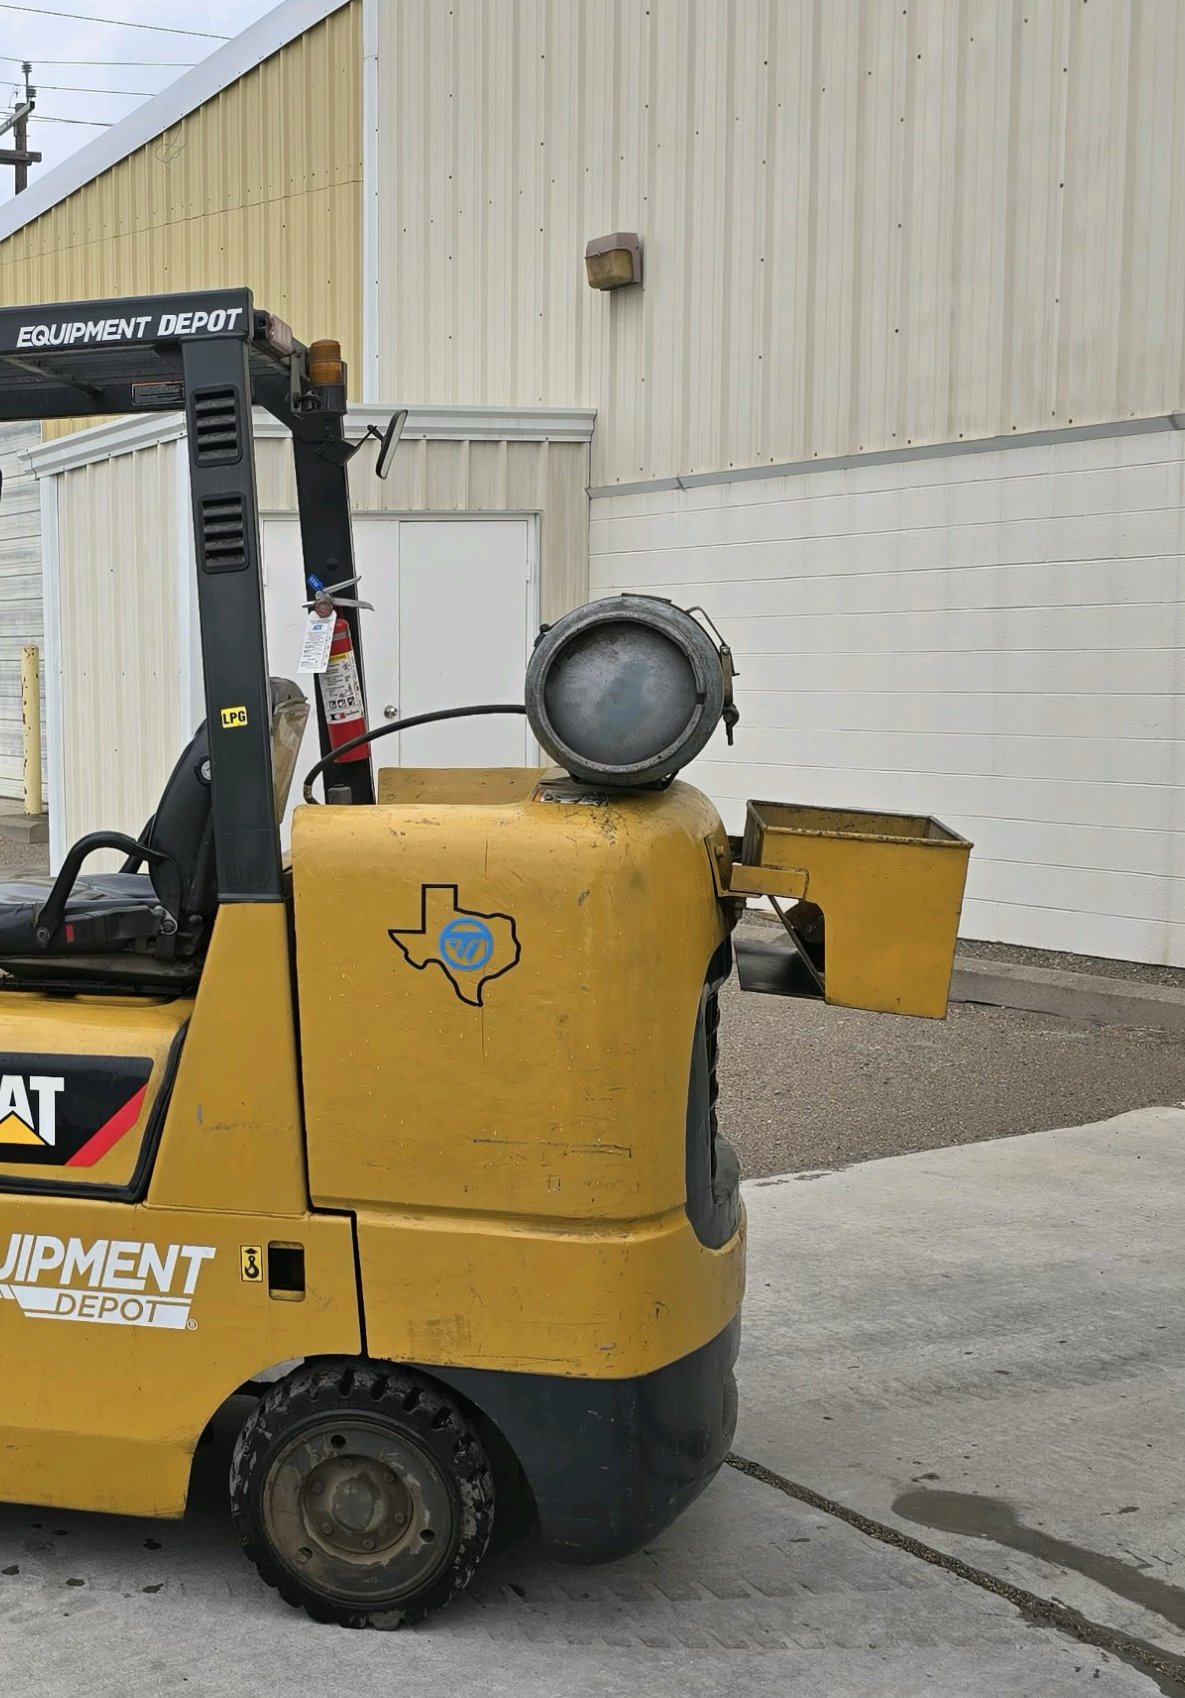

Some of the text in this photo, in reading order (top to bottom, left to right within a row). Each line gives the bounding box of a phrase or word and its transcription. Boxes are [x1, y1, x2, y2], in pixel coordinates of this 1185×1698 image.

[16, 308, 243, 348] EQUIPMENT DEPOT
[222, 710, 246, 725] LPG
[54, 1292, 160, 1324] DEPOT
